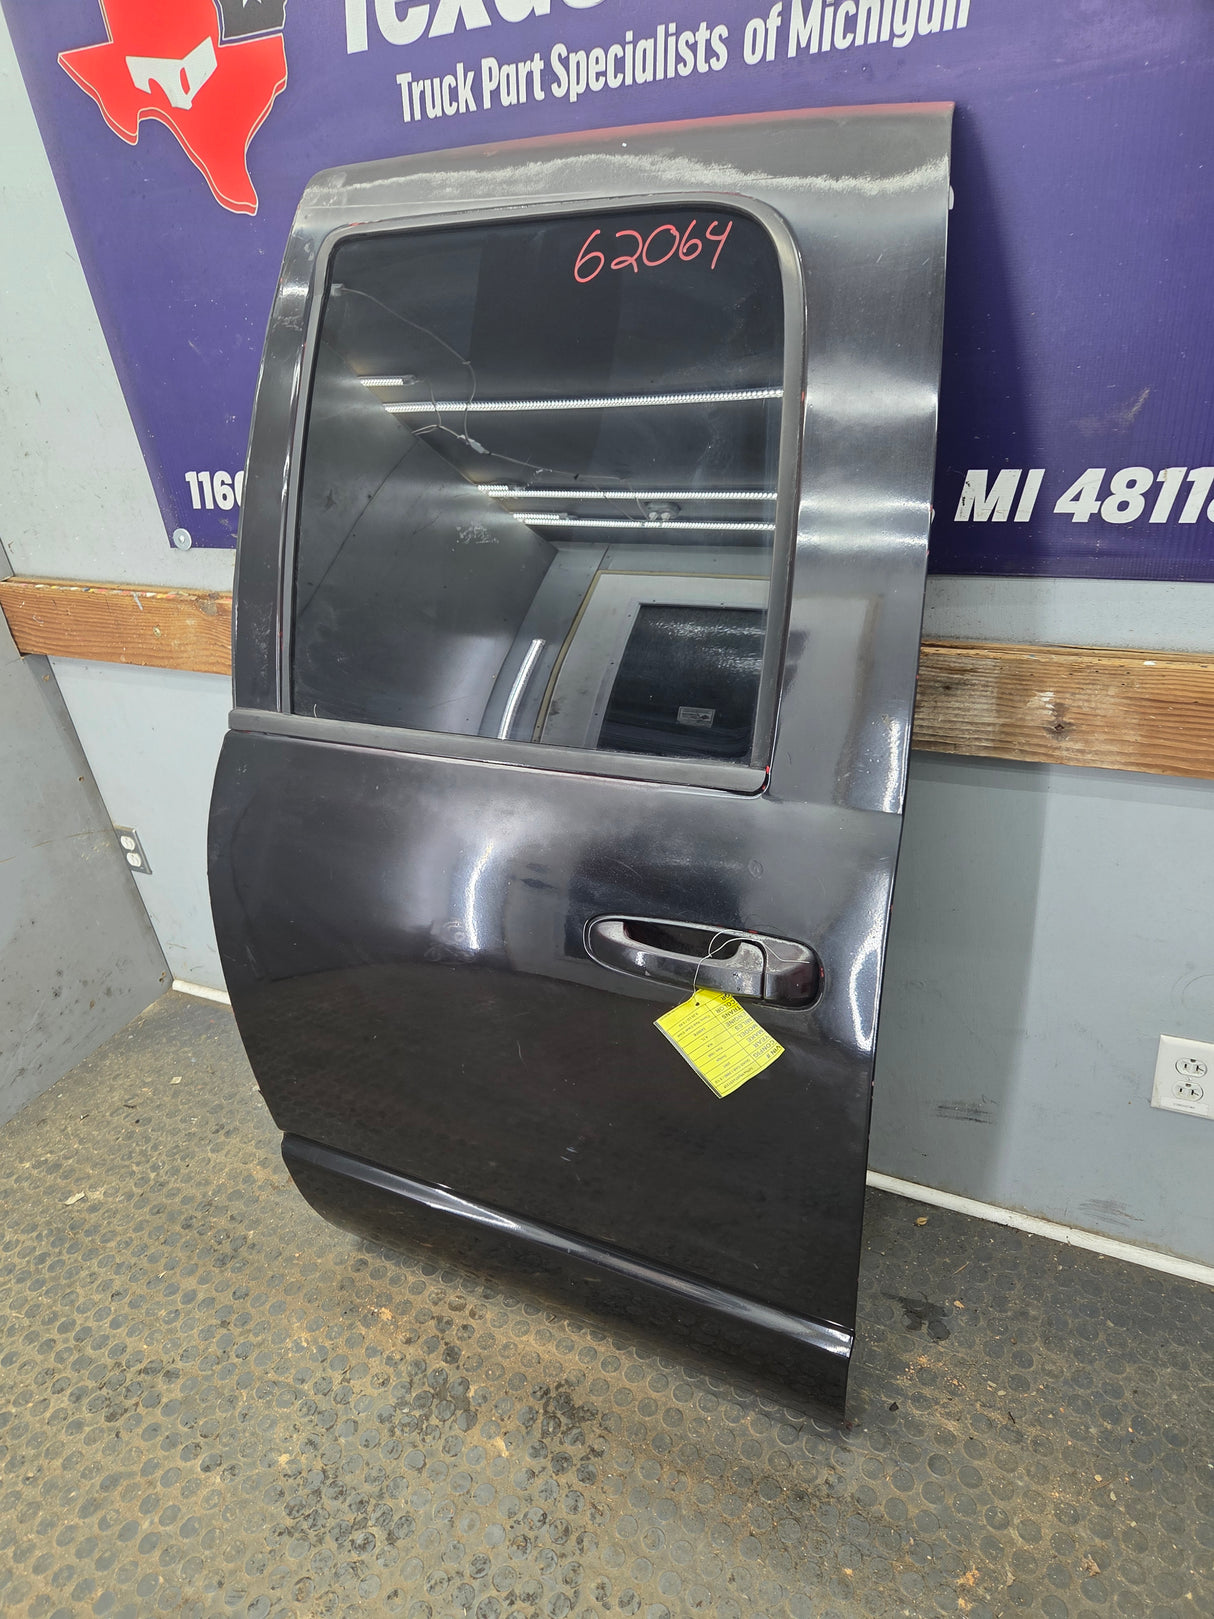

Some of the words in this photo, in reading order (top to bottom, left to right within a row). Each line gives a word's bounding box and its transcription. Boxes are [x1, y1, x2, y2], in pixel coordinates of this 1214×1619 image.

[396, 62, 477, 123] Truck
[481, 52, 545, 110] Part
[550, 21, 729, 103] Specialists
[743, 2, 783, 65] of
[787, 0, 971, 58] Michigan
[574, 219, 733, 283] 62064
[953, 468, 1046, 522] MI
[1053, 466, 1214, 524] 4811
[713, 998, 737, 1013] COLOR
[720, 1004, 742, 1019] TRANS
[735, 1022, 759, 1039] MODEL
[751, 1038, 776, 1058] CONFIG
